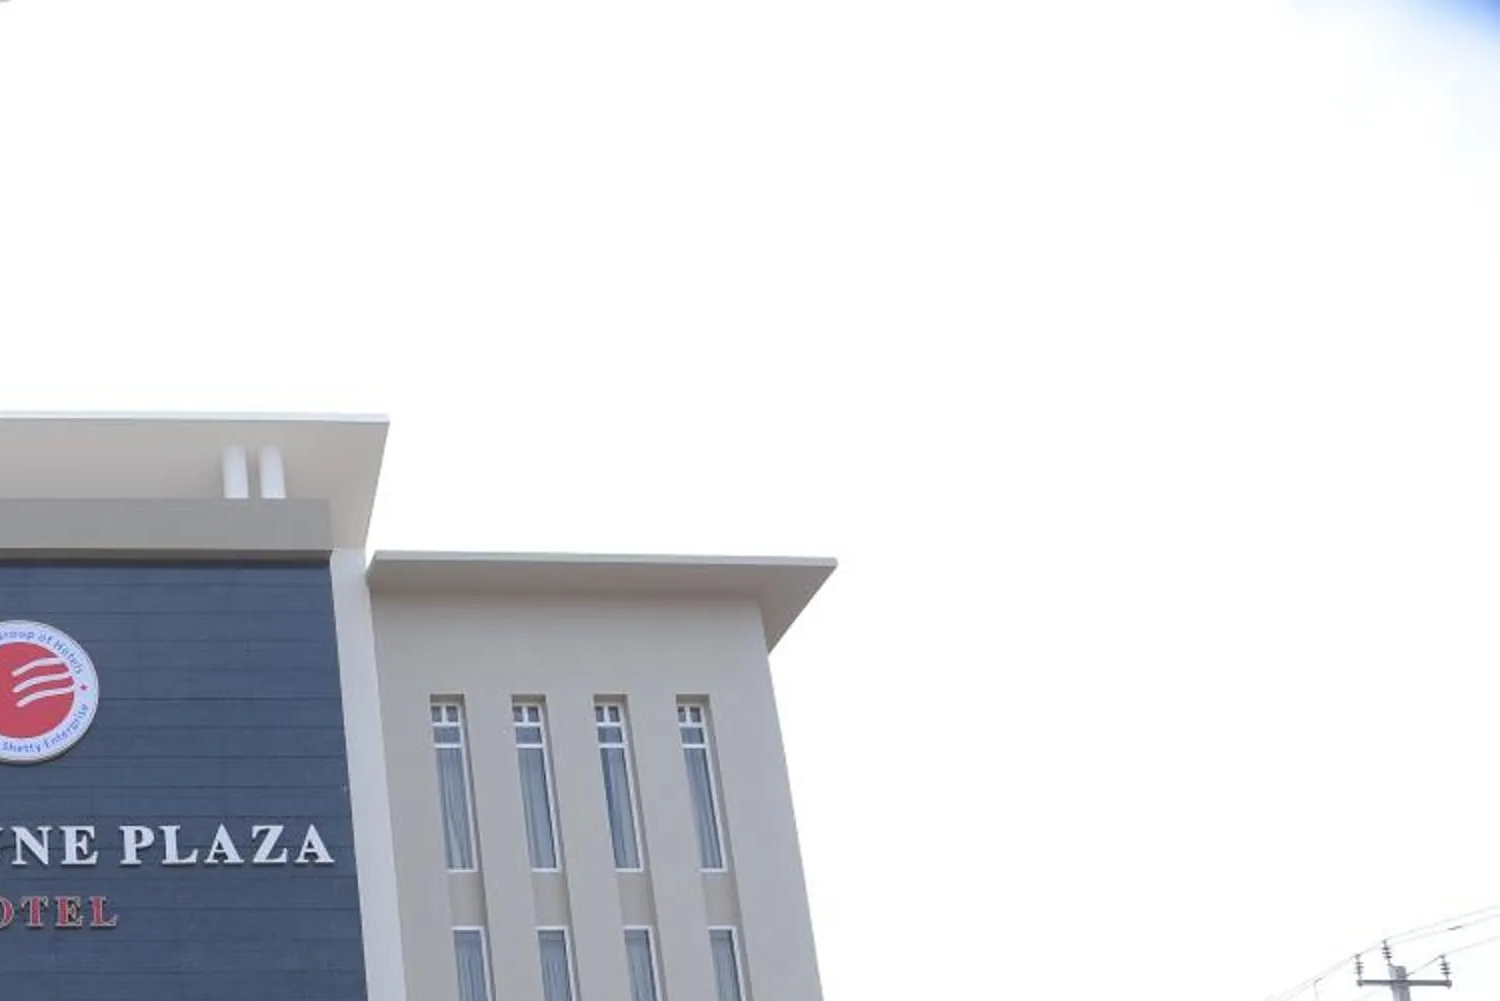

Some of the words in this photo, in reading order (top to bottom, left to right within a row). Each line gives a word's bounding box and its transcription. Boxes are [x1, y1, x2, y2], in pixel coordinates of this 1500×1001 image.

[38, 632, 53, 644] of
[54, 640, 84, 675] Hotels
[119, 823, 335, 866] PLAZA
